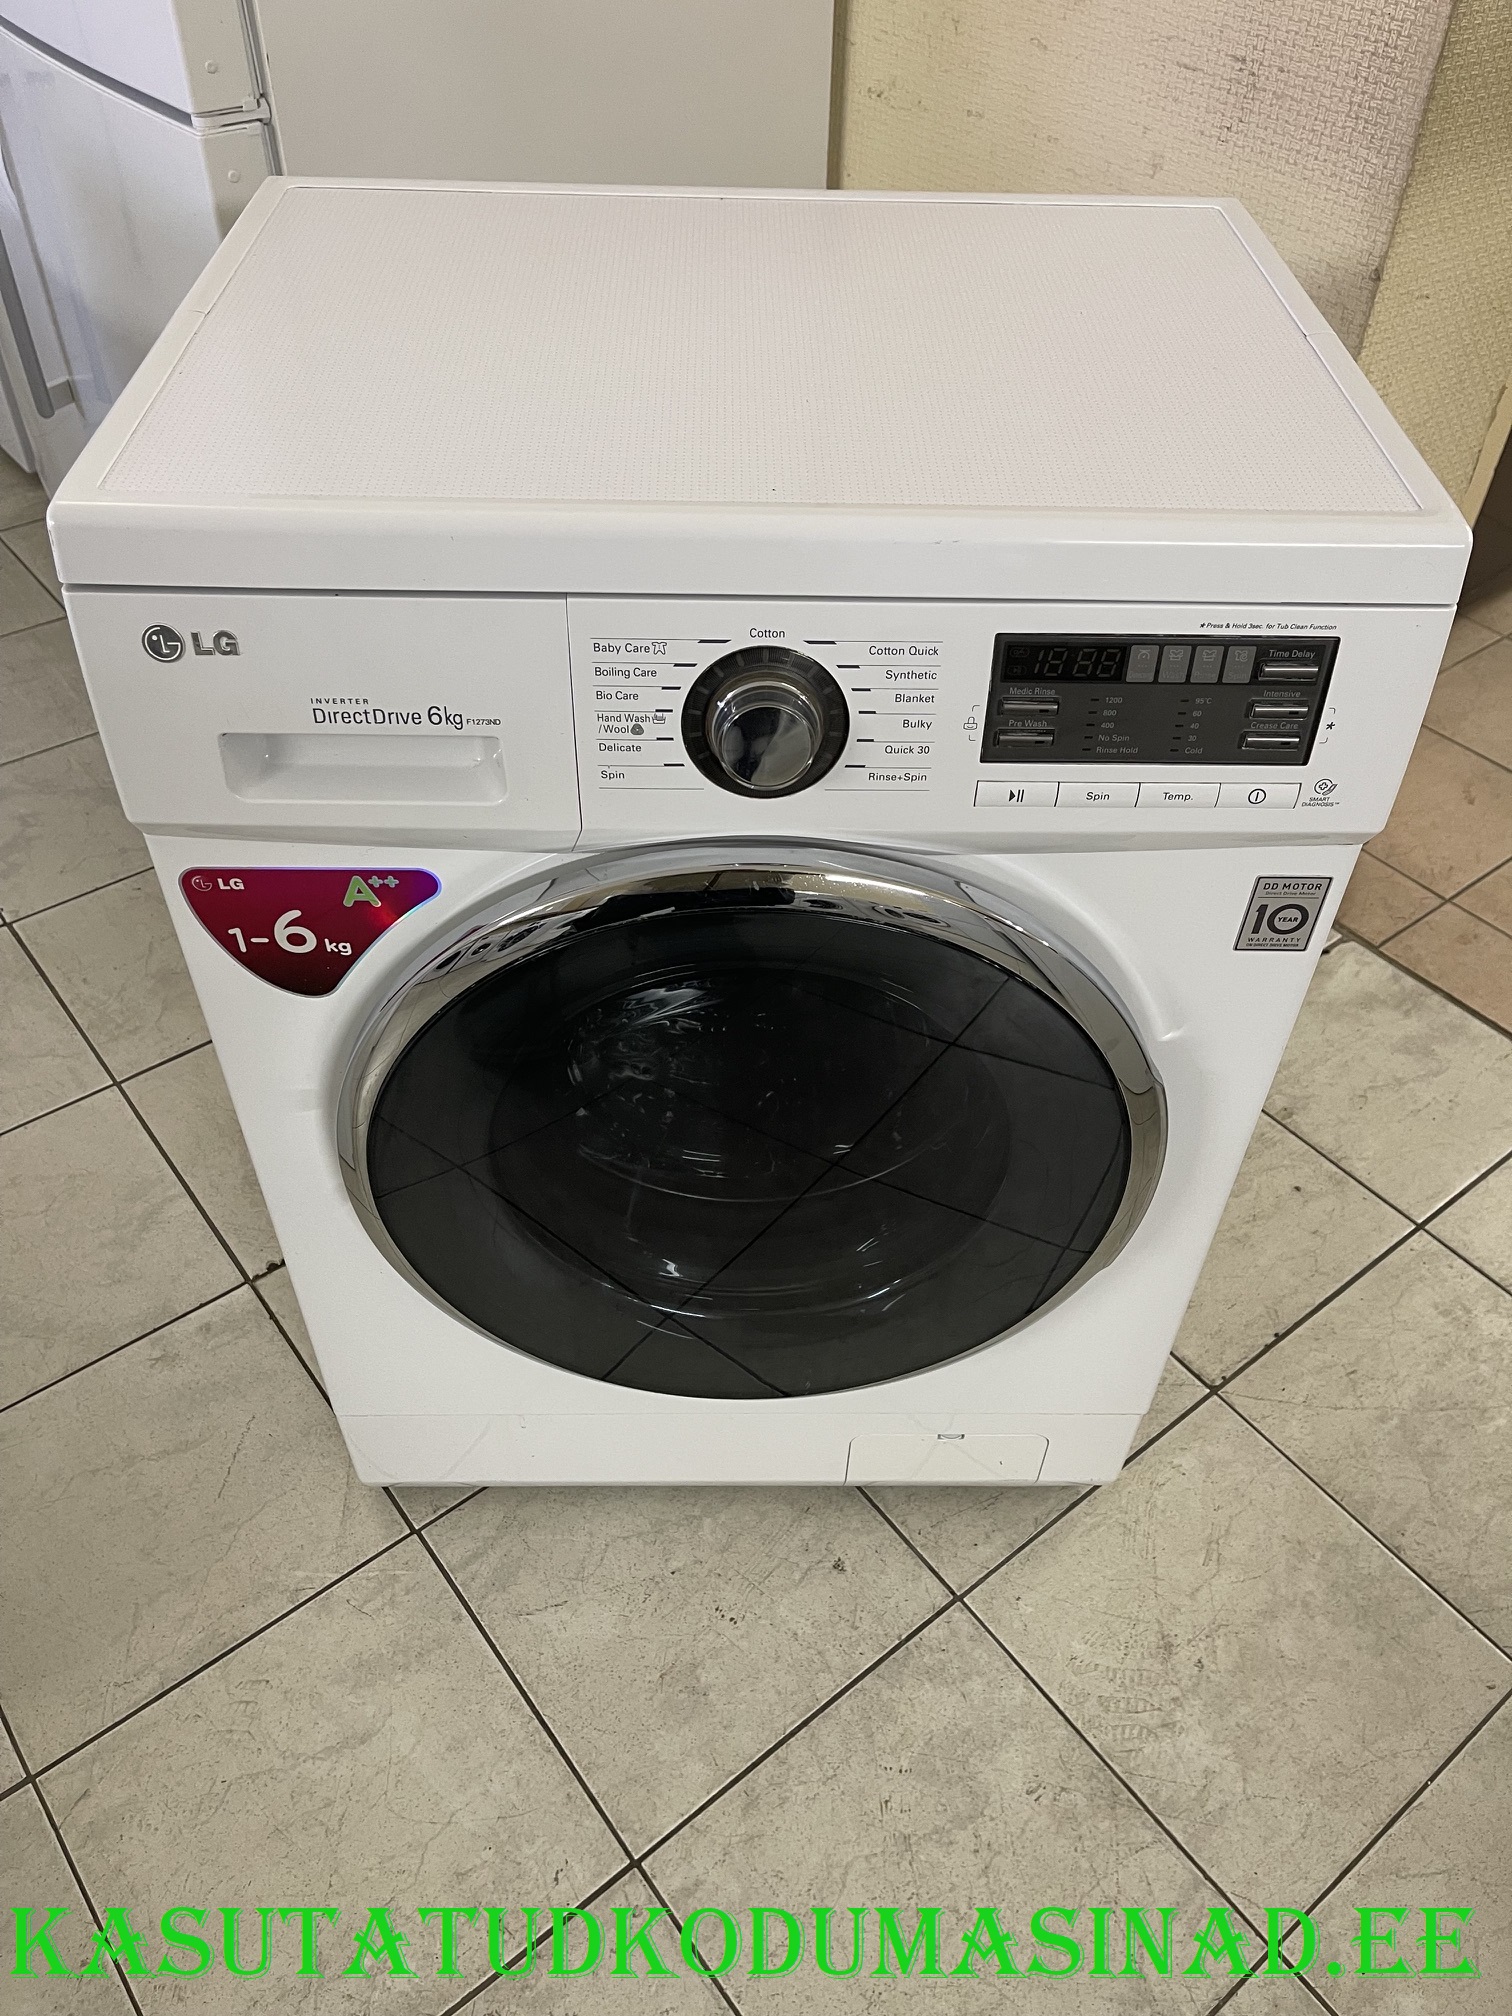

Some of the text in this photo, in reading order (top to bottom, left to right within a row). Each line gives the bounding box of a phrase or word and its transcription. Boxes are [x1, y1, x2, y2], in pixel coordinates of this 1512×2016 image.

[749, 627, 786, 638] Cotton
[191, 629, 241, 656] LG
[593, 643, 650, 655] Baby Care
[869, 645, 939, 656] Cotton Quick
[1269, 650, 1315, 659] Time Delay
[594, 667, 657, 679] Boiling Care
[885, 670, 937, 681] Synthetic
[596, 691, 639, 700] Bio Care
[1009, 687, 1056, 695] Medic Rinse
[1263, 690, 1301, 698] Intensive
[310, 697, 369, 705] INVERTER
[895, 694, 935, 703] Blanket
[466, 718, 501, 726] F1273ND
[597, 713, 650, 723] Hand Wash
[902, 719, 932, 731] Bulky
[1280, 722, 1299, 730] Care
[1112, 734, 1130, 742] Spin
[599, 743, 642, 752] Delicate
[884, 745, 930, 755] Quick 30
[1096, 746, 1139, 754] Rinse Hold
[600, 770, 625, 780] Spin
[868, 773, 927, 783] Rinse+Spin
[1085, 791, 1110, 801] Spin
[1163, 792, 1193, 801] Temp.
[217, 878, 245, 890] LG
[1263, 882, 1279, 890] DD
[1251, 903, 1309, 935] 10
[324, 938, 352, 956] kg
